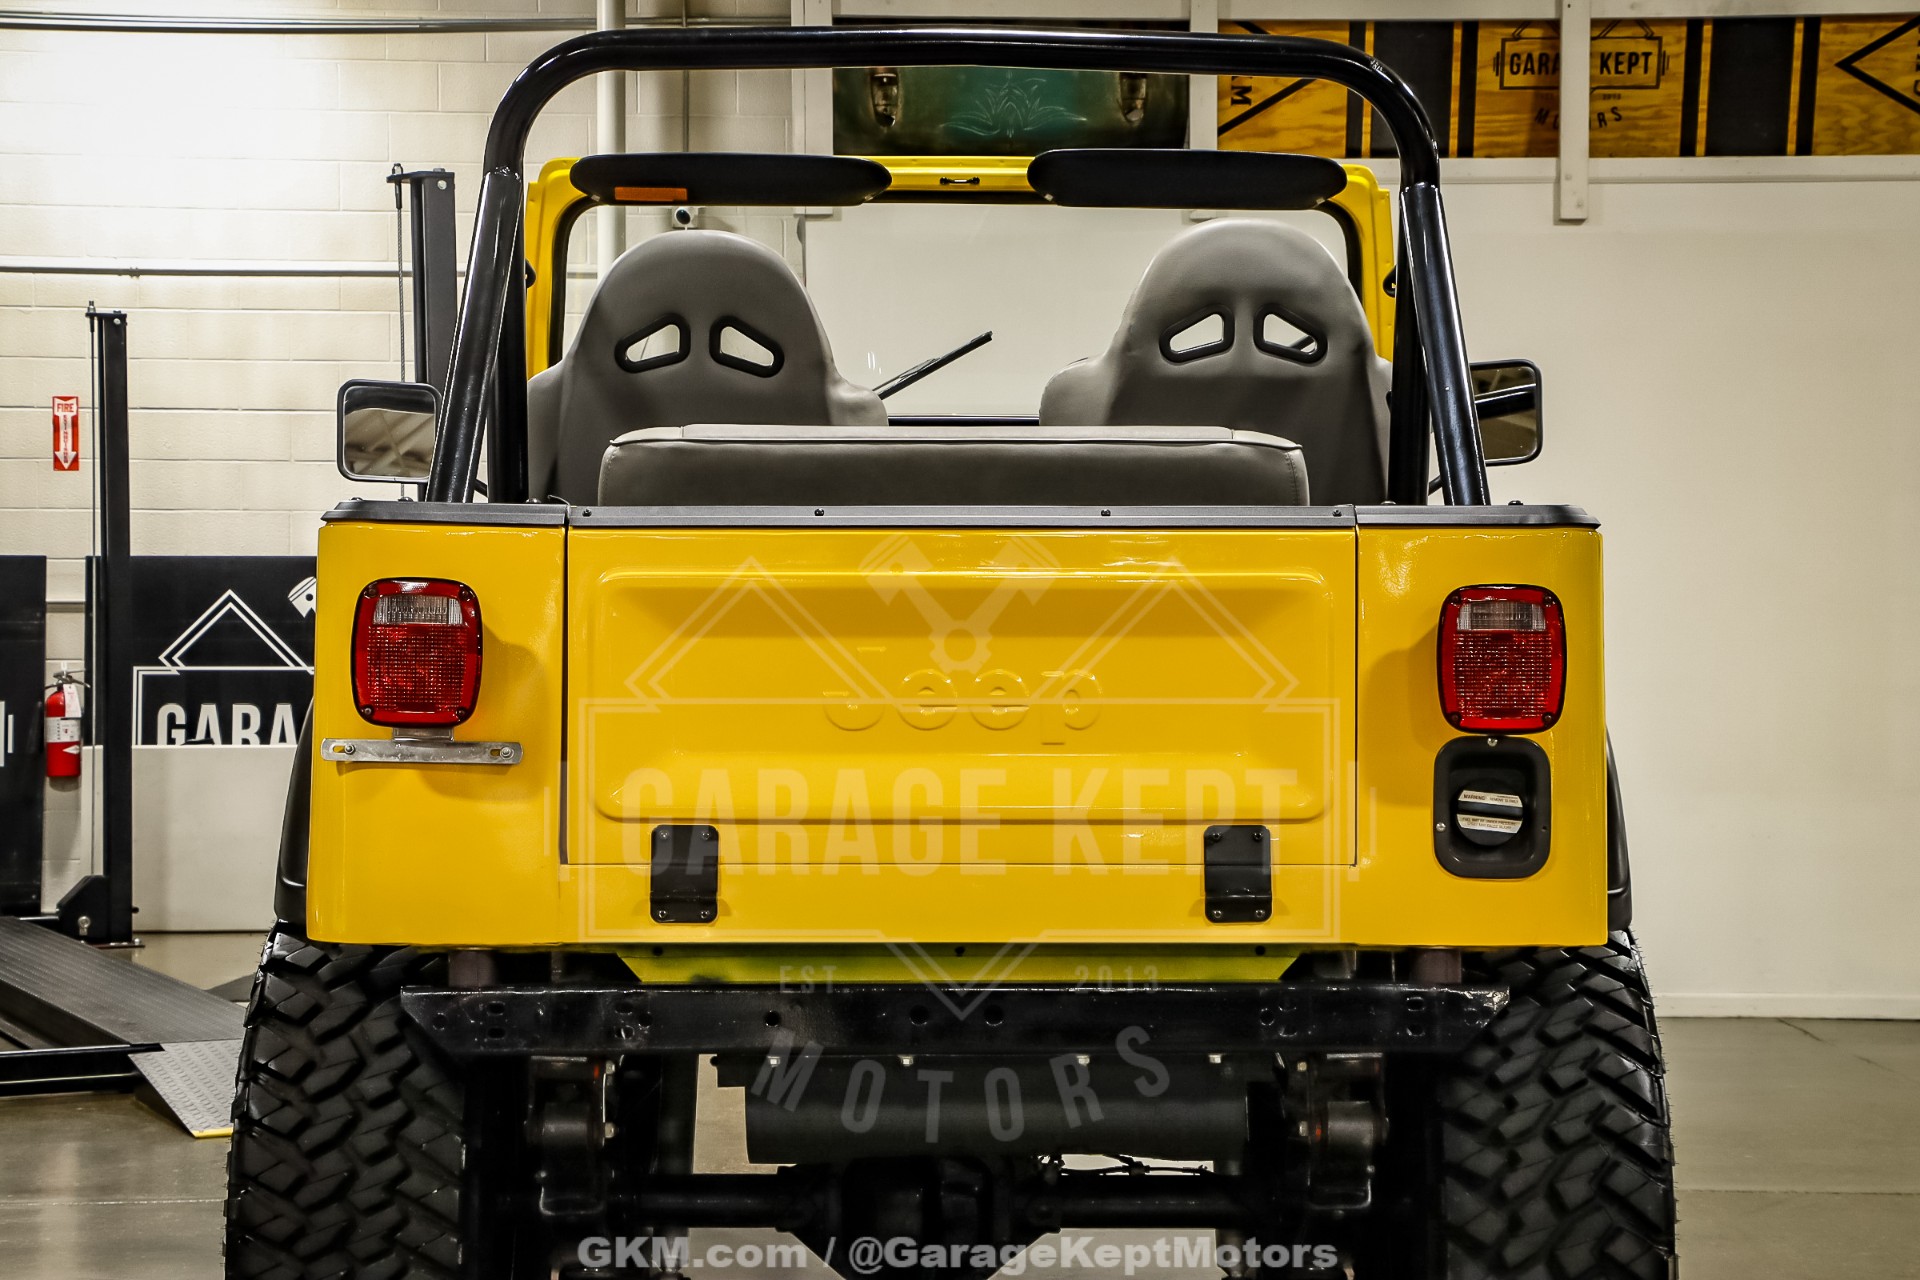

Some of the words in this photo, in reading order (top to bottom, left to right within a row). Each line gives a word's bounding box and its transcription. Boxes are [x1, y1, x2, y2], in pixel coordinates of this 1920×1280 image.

[1600, 51, 1653, 75] KEPT
[57, 403, 74, 412] FIRE
[822, 646, 1103, 746] Jeep
